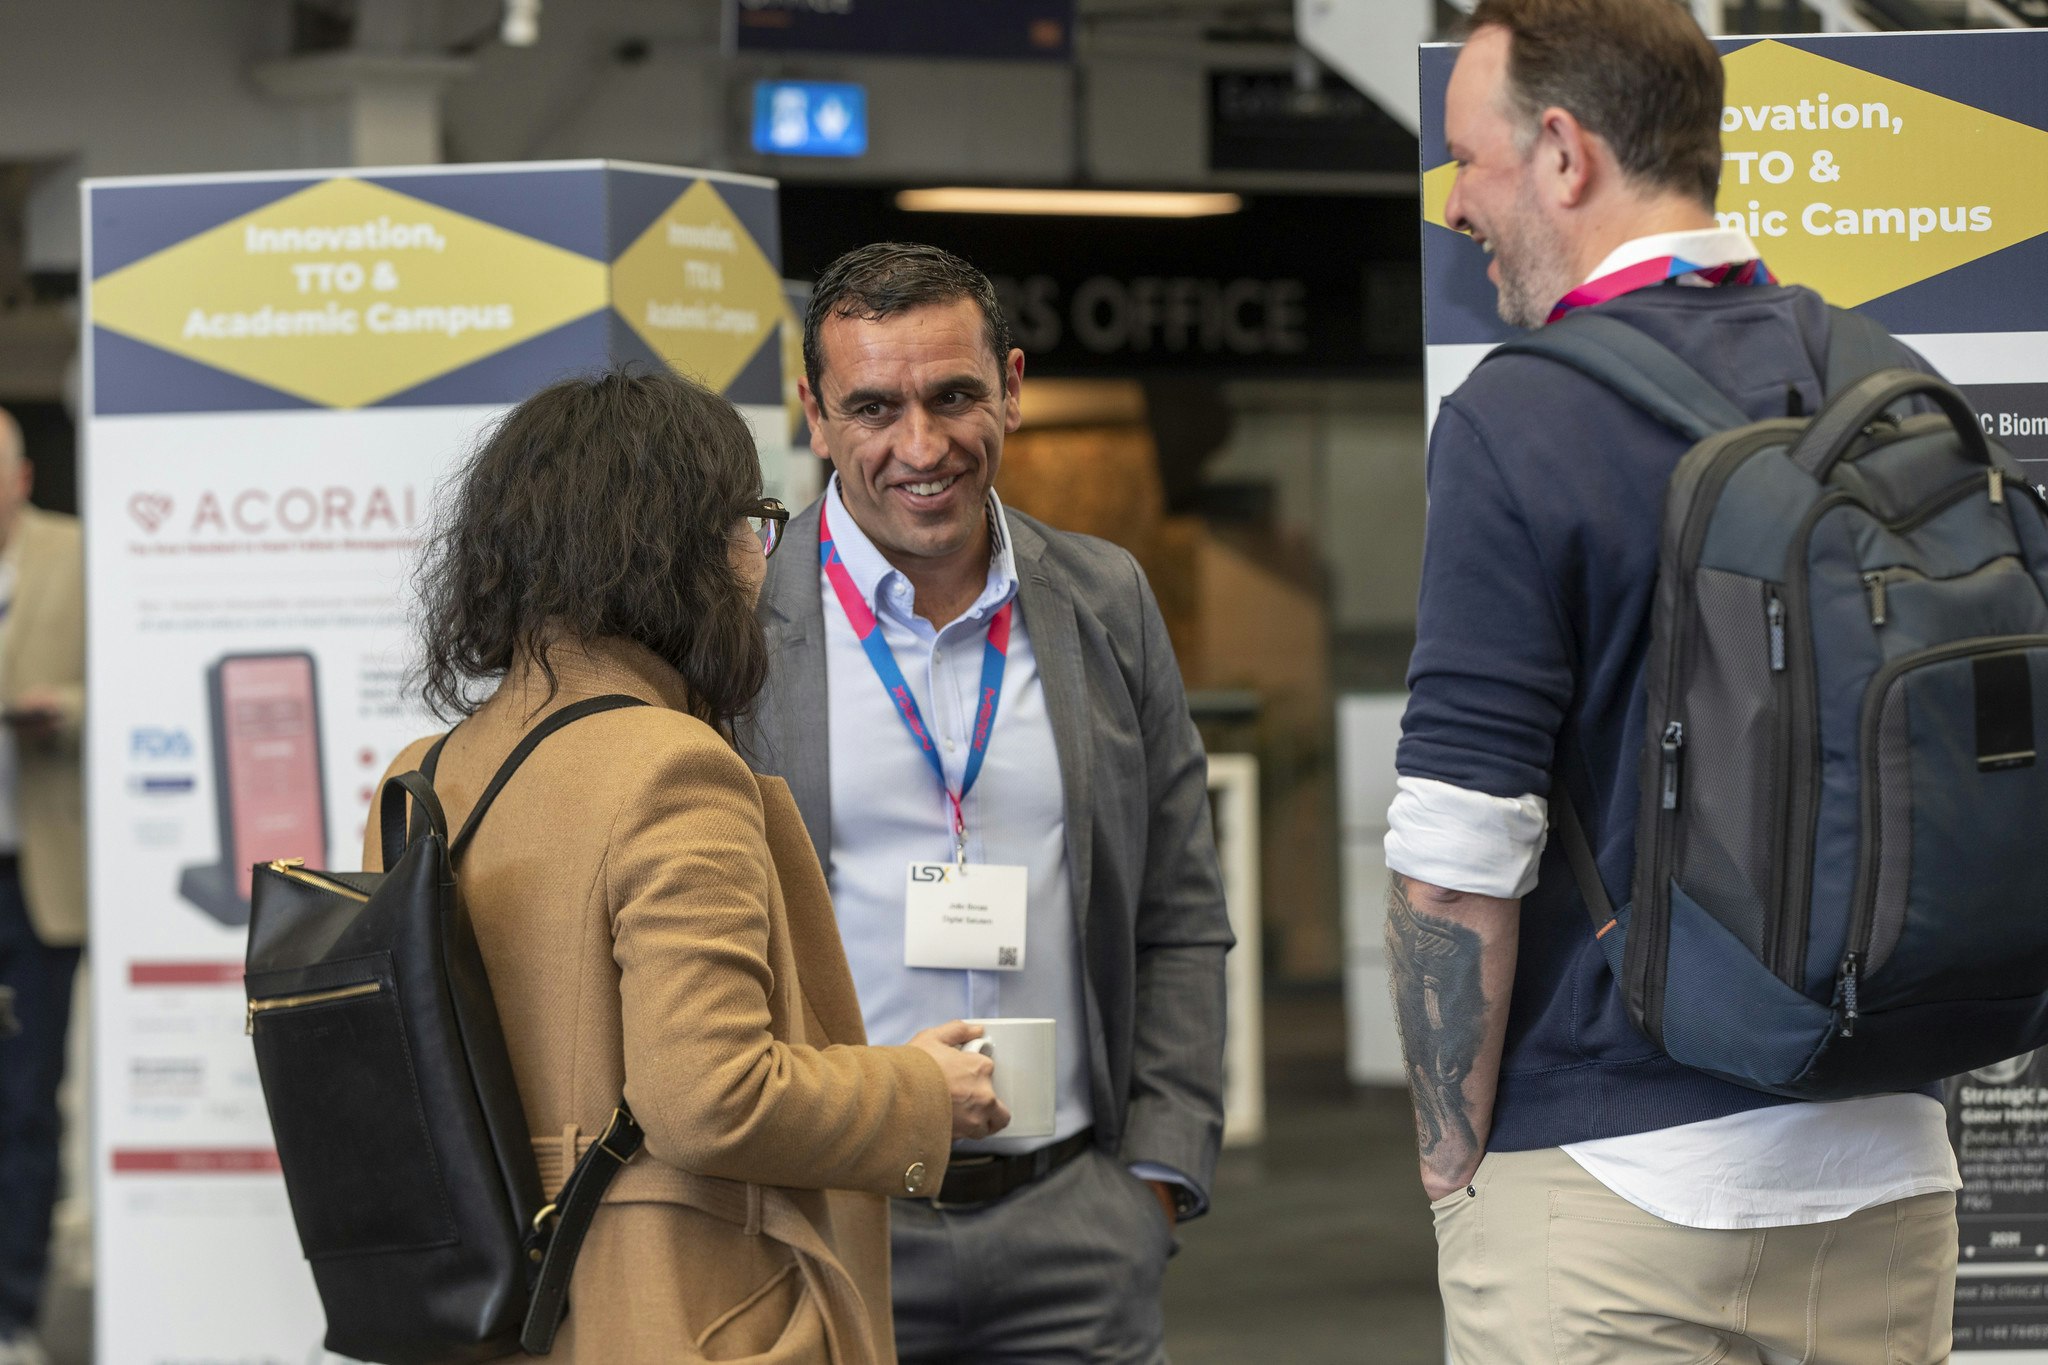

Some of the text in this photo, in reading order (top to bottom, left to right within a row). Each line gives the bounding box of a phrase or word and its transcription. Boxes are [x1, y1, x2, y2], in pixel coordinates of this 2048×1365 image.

[1719, 92, 1904, 134] ovation,
[1809, 150, 1841, 183] &
[244, 217, 446, 254] Innovation,
[1801, 202, 1993, 241] Campus
[292, 261, 398, 294] TTO &
[183, 302, 514, 340] Academic Campus
[1071, 276, 1308, 353] OFFICE
[191, 485, 416, 533] ACORAI
[912, 865, 952, 884] LSX
[1960, 1086, 2035, 1107] Strategic
